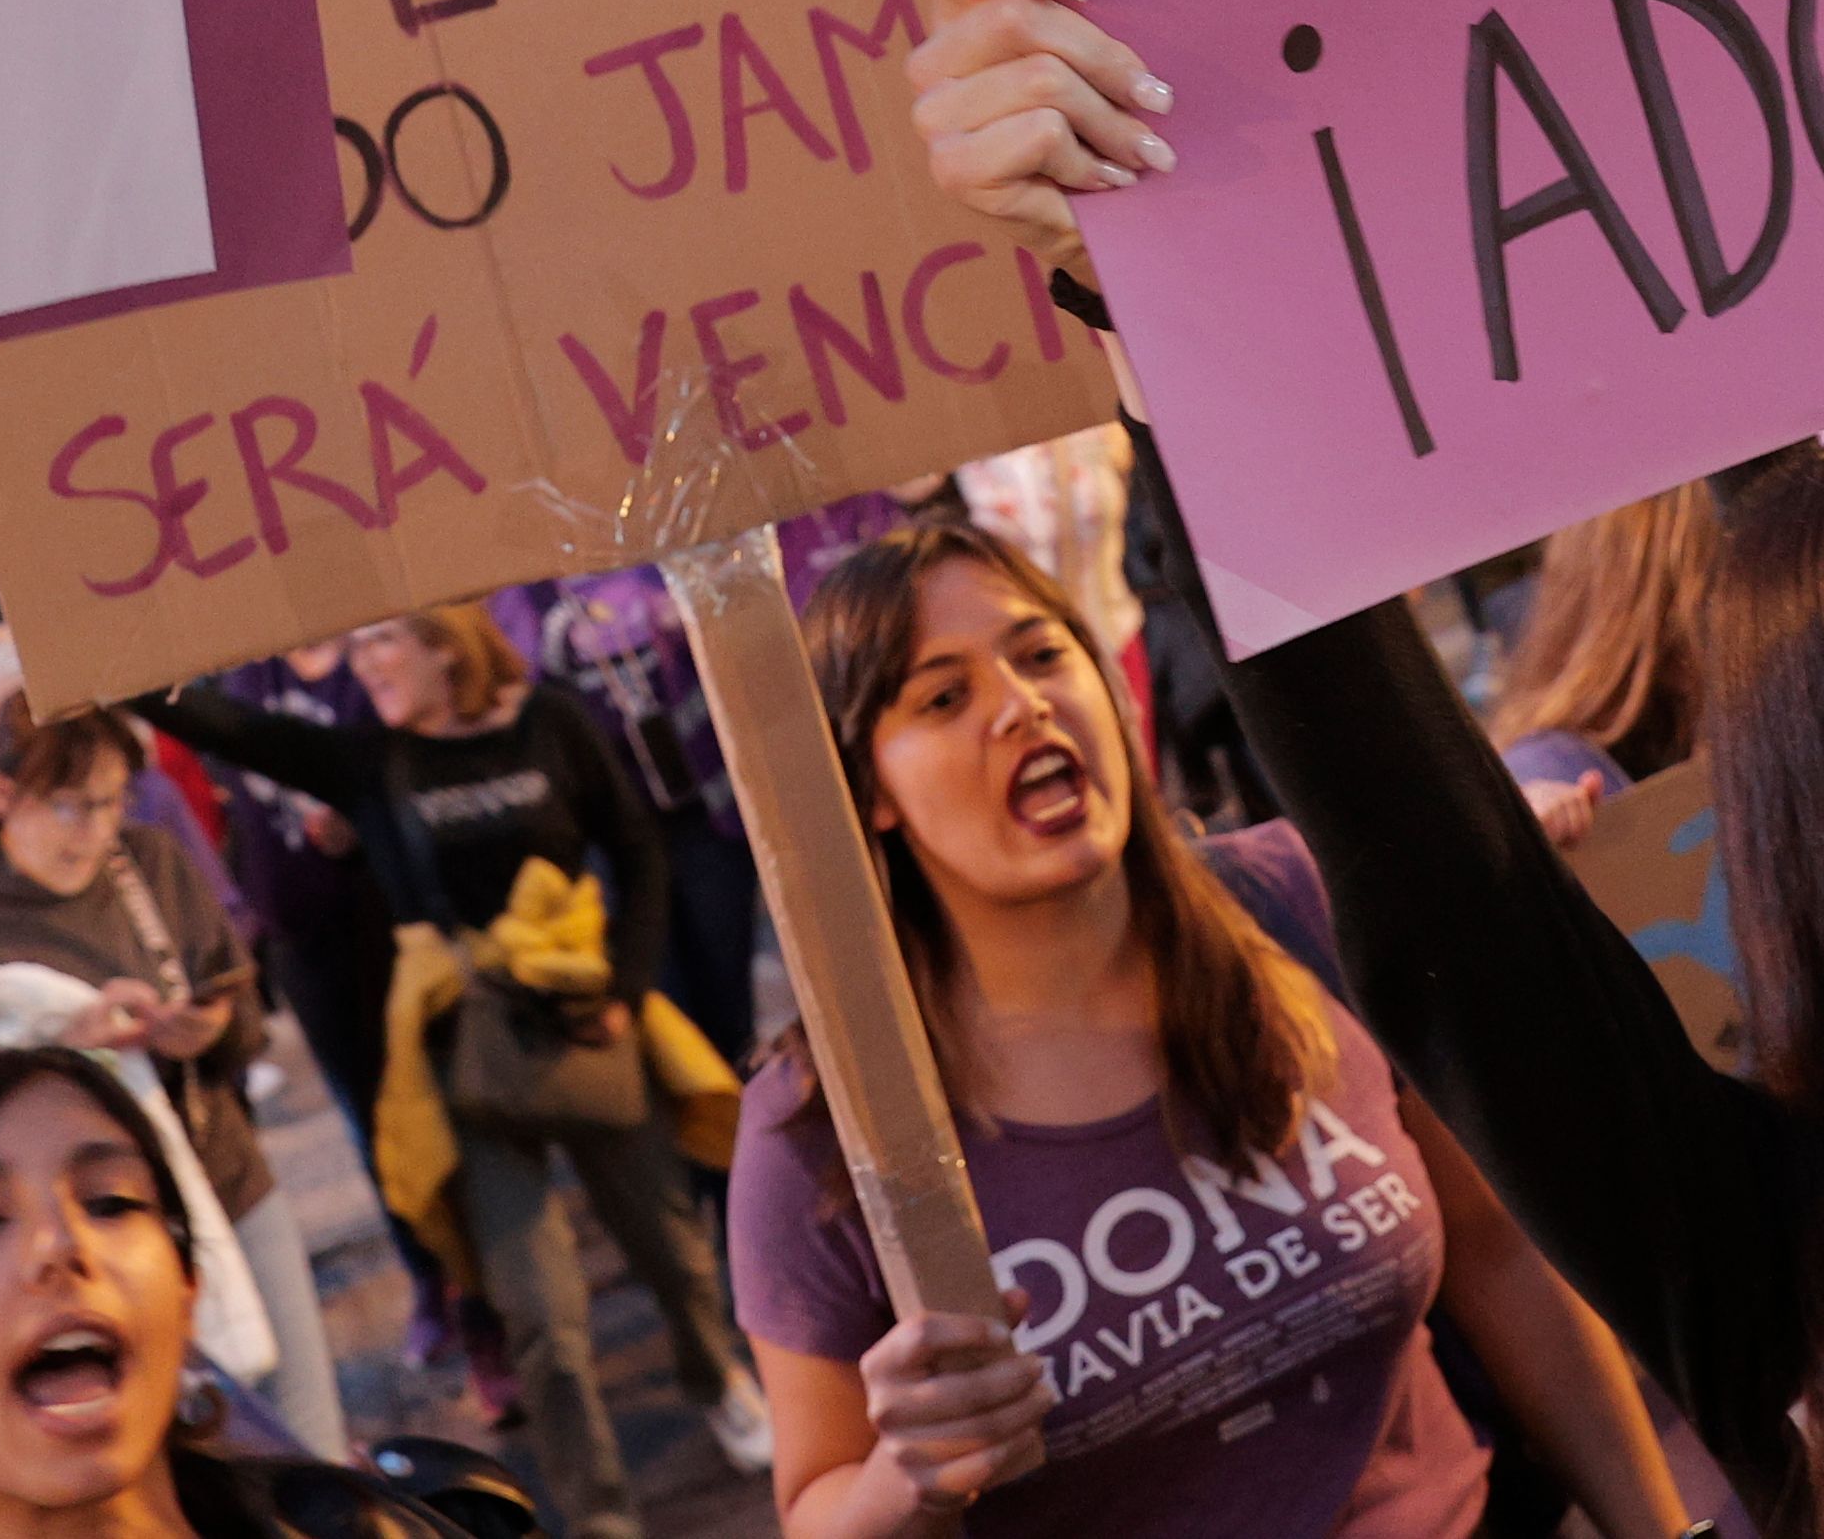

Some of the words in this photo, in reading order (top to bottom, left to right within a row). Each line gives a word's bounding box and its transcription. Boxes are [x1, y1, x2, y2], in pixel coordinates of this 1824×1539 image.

[47, 314, 489, 599] SERÁ
[990, 1097, 1388, 1354] DONA
[1223, 1227, 1323, 1302] DE
[1320, 1171, 1423, 1254] SER
